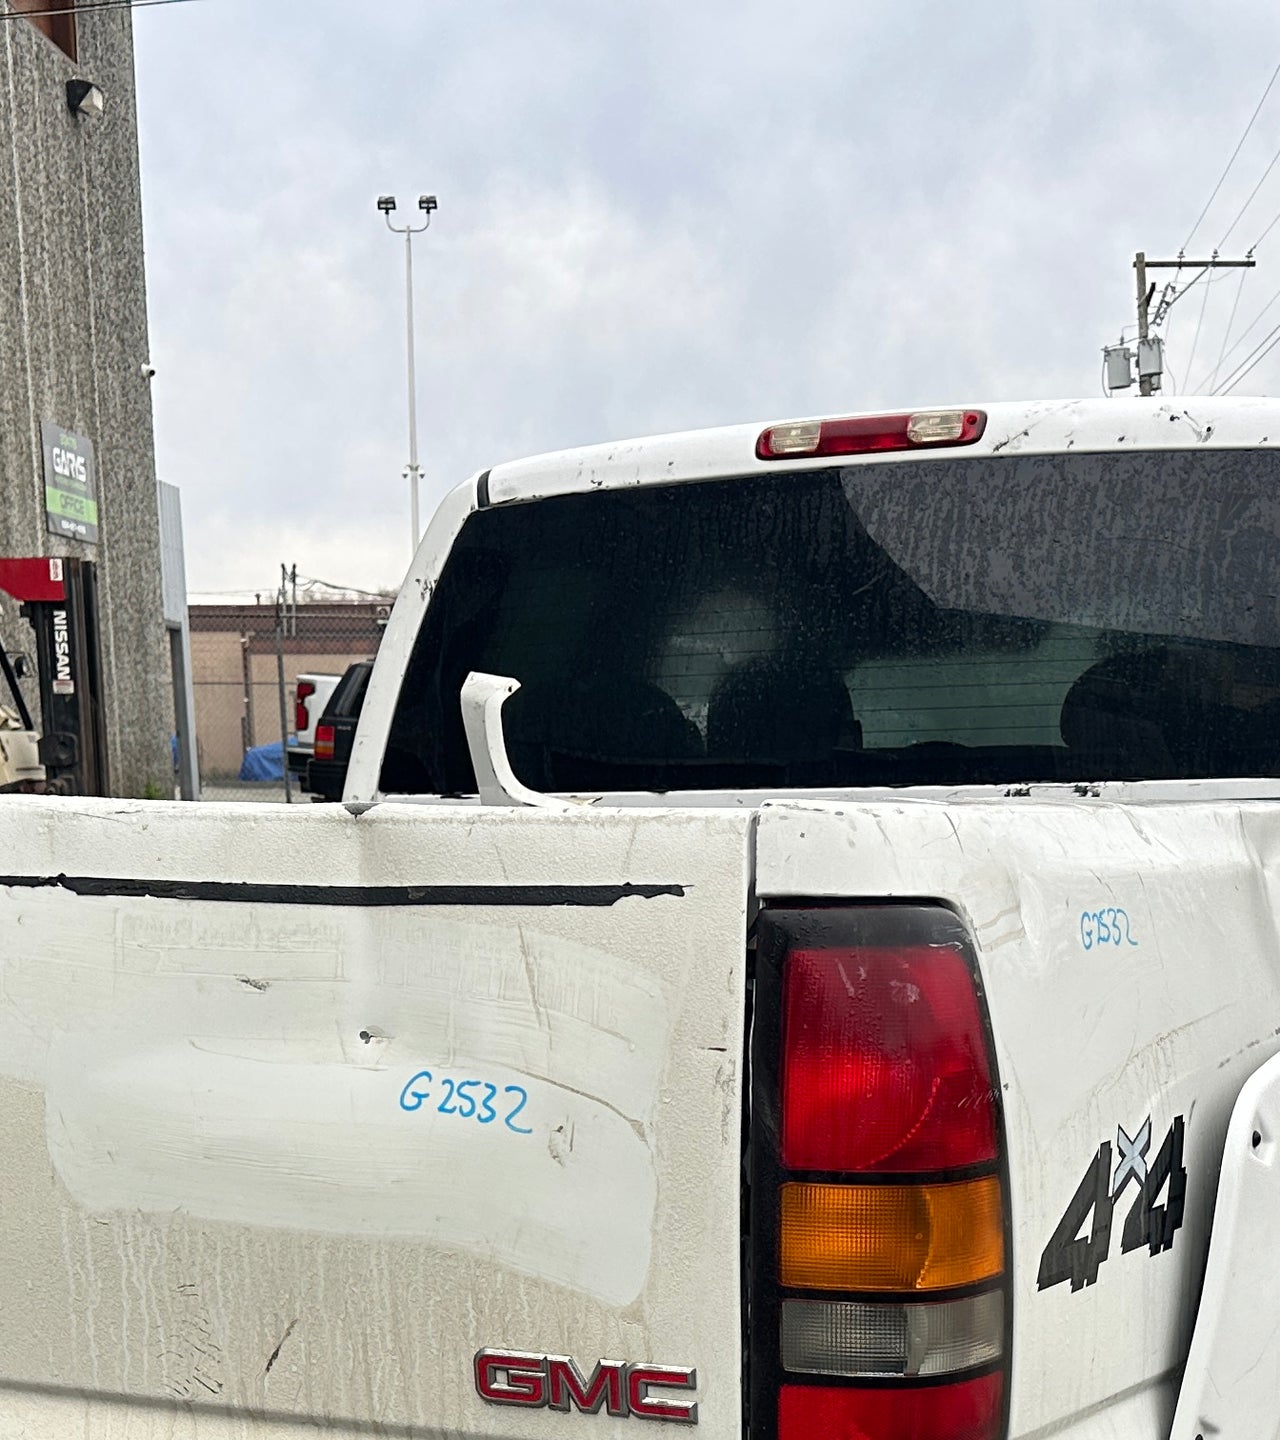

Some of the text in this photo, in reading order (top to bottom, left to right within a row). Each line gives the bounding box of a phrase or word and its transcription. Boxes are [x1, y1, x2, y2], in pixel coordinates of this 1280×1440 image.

[53, 609, 72, 680] NISSAN
[1081, 908, 1139, 951] G2532
[400, 1071, 533, 1134] G2532
[474, 1346, 699, 1425] GMC
